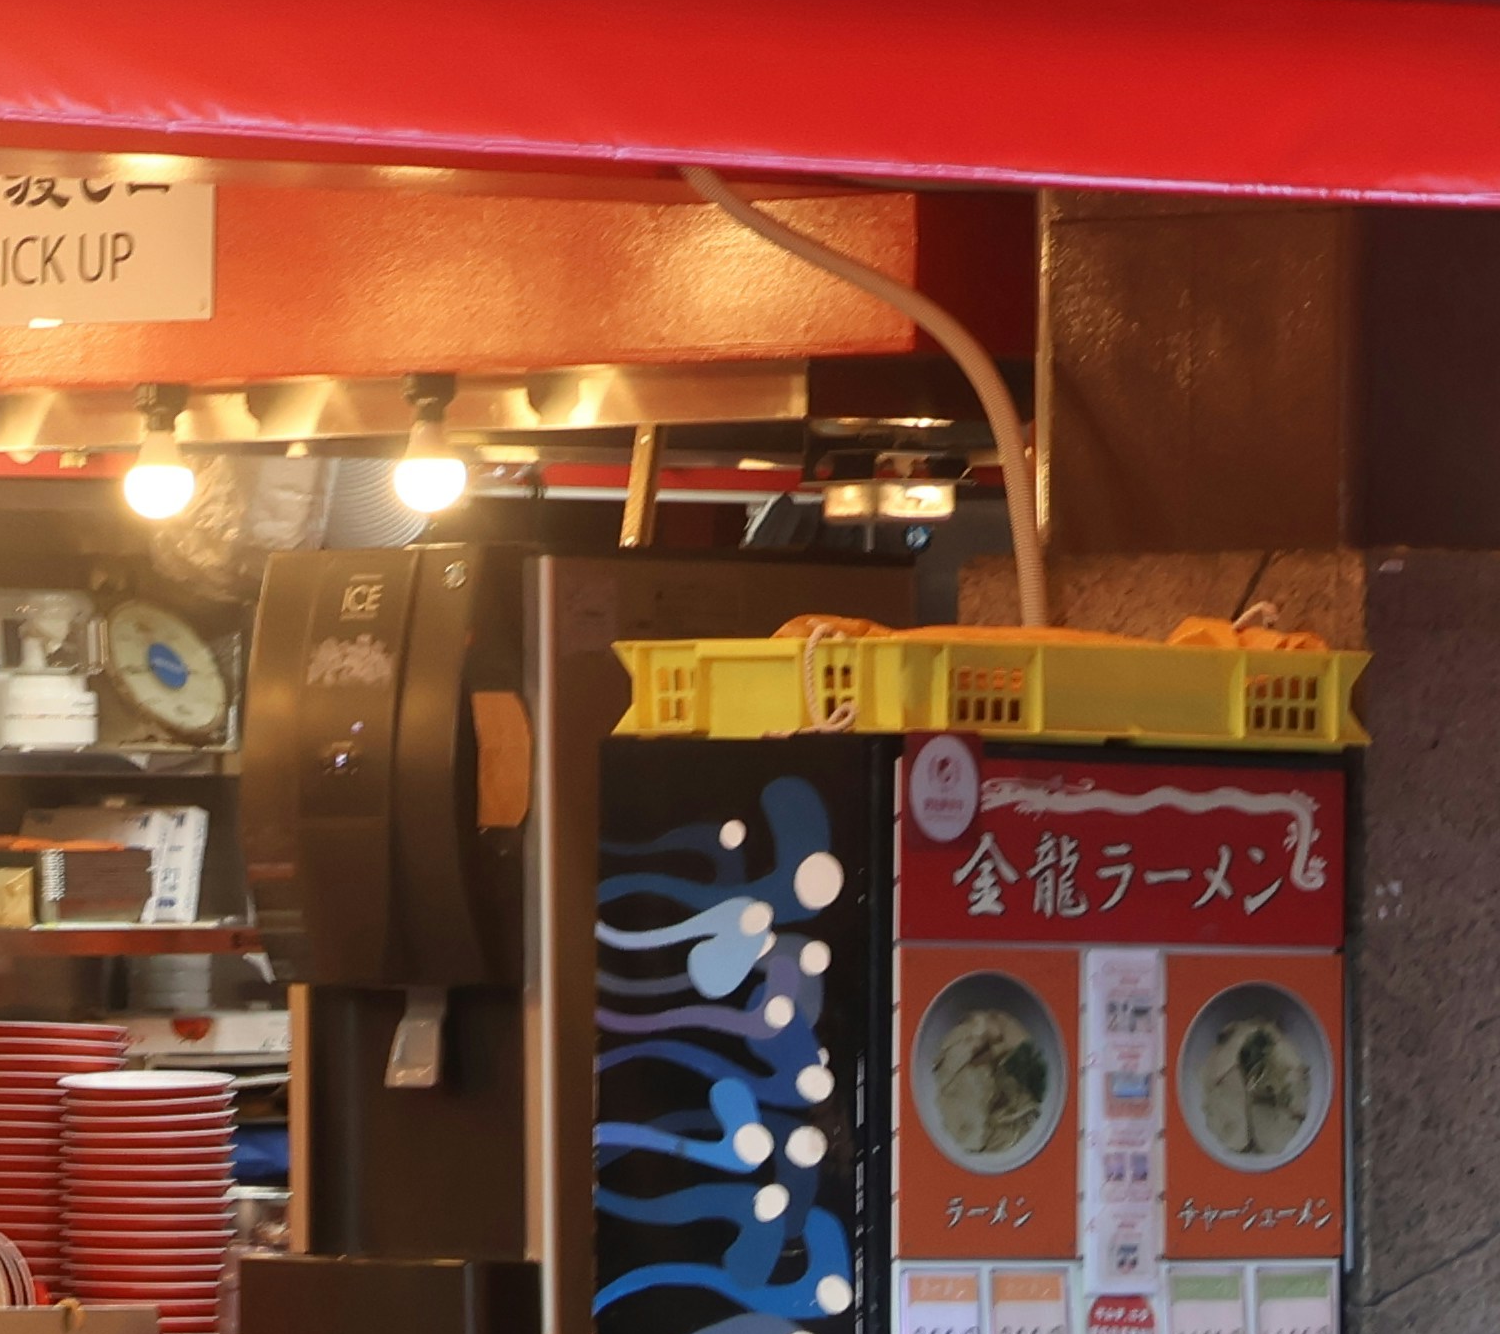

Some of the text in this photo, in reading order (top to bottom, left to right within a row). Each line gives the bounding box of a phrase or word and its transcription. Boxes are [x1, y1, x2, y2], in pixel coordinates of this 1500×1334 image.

[77, 231, 136, 284] UP
[341, 584, 384, 614] ICE
[952, 831, 1283, 919] 金龍ラーメン
[945, 1195, 1033, 1229] ラーメン
[1176, 1197, 1333, 1232] チャーシューメン
